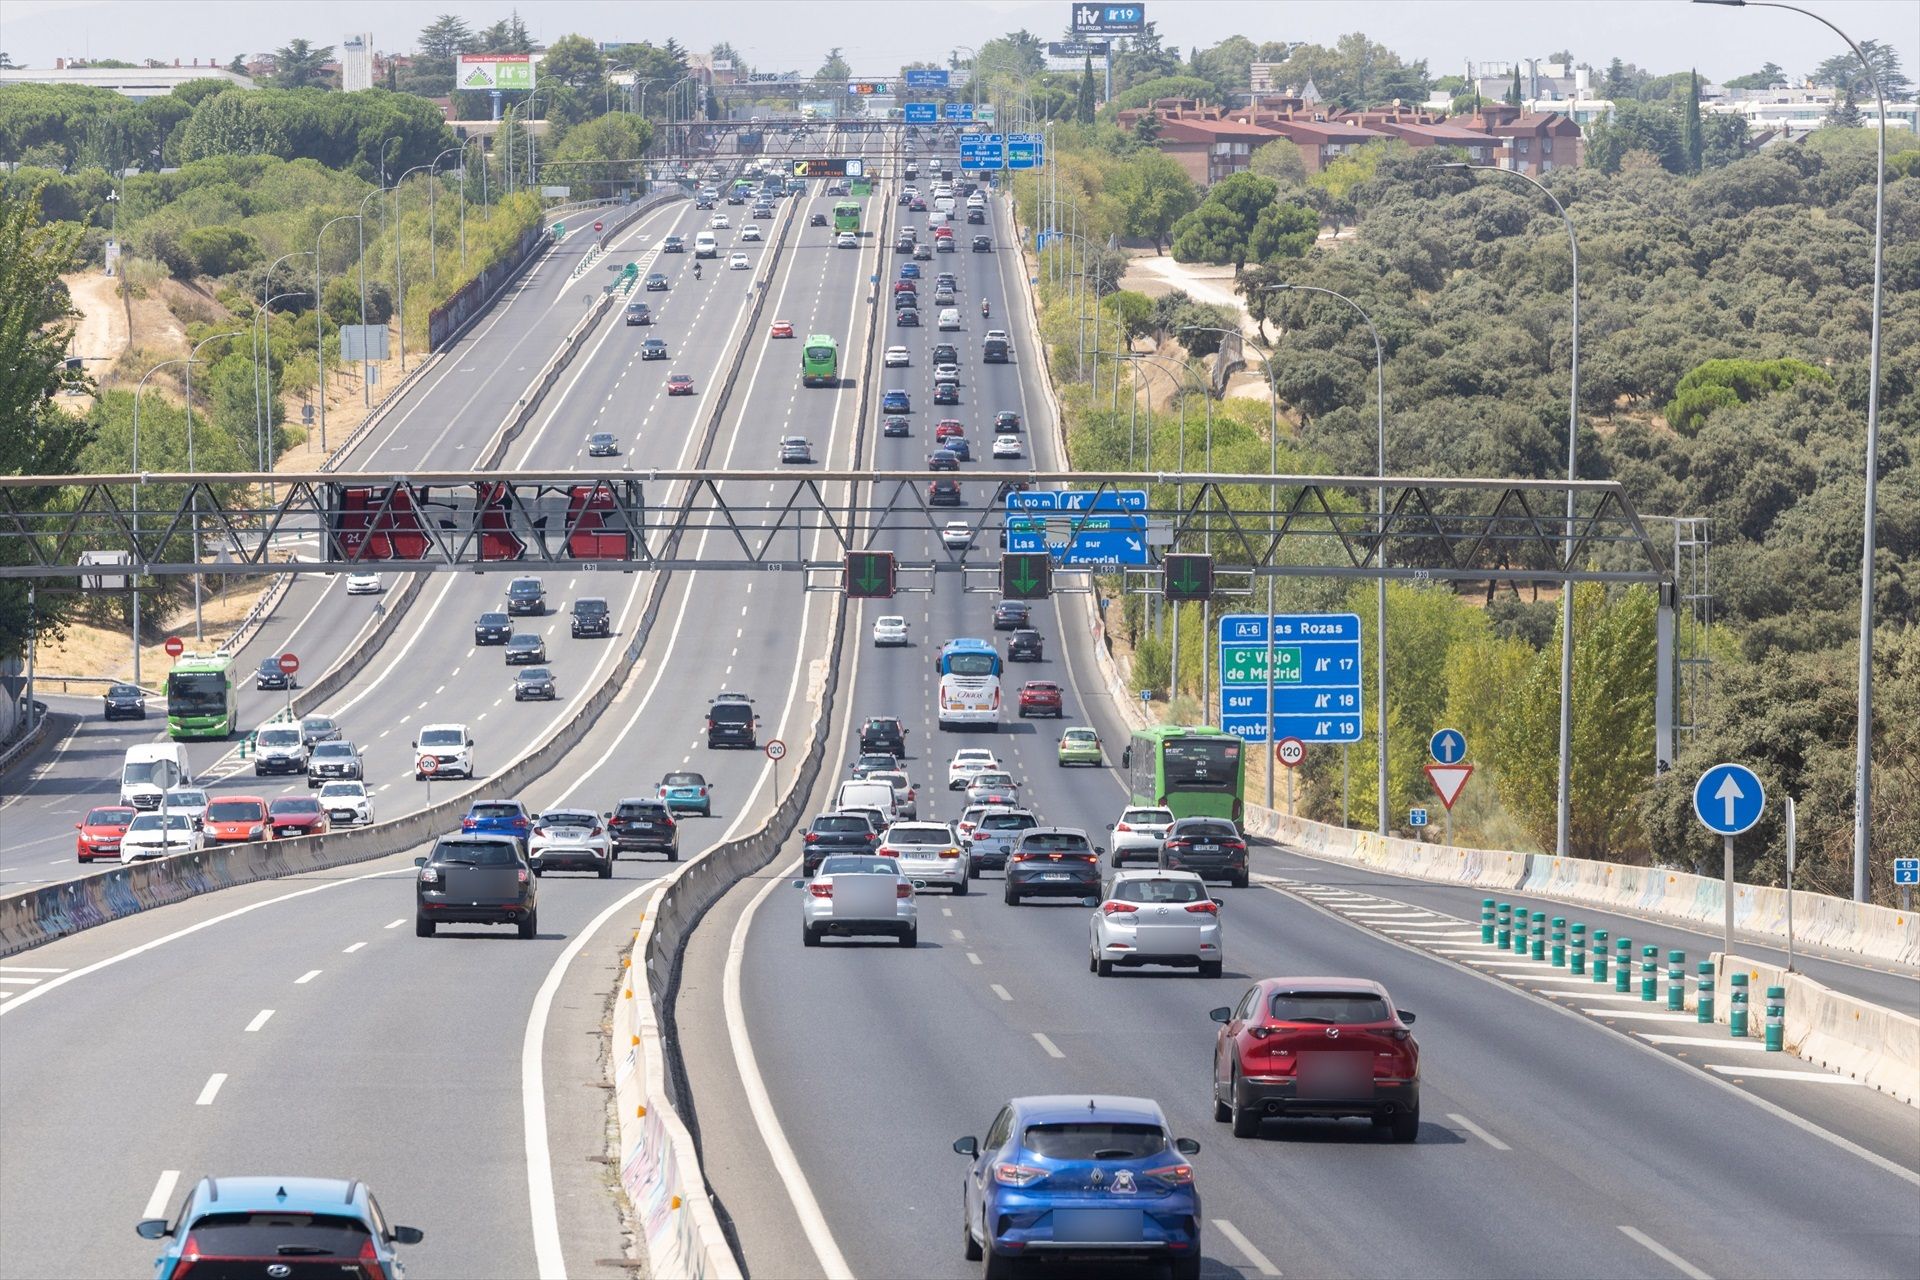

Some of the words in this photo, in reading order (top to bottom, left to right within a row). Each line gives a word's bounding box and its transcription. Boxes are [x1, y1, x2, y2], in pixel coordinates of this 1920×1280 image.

[1077, 6, 1099, 25] itv
[1120, 9, 1134, 20] 19
[463, 70, 477, 86] LEROY
[476, 66, 494, 85] MERLIN
[1014, 539, 1035, 549] Las
[1085, 540, 1101, 548] sur
[1070, 555, 1119, 564] Escorial
[1238, 624, 1258, 634] A-6
[1272, 624, 1292, 634] as
[1300, 623, 1343, 634] Rozas
[1339, 658, 1354, 670] 17
[1227, 667, 1245, 680] de
[1250, 667, 1299, 680] Madrid
[1229, 696, 1253, 707] sur
[1339, 694, 1354, 706] 18
[1229, 723, 1276, 735] centr
[1339, 722, 1354, 734] 19
[770, 746, 782, 754] 120
[1282, 746, 1300, 757] 120
[1415, 816, 1422, 824] 3
[1903, 871, 1911, 882] 2
